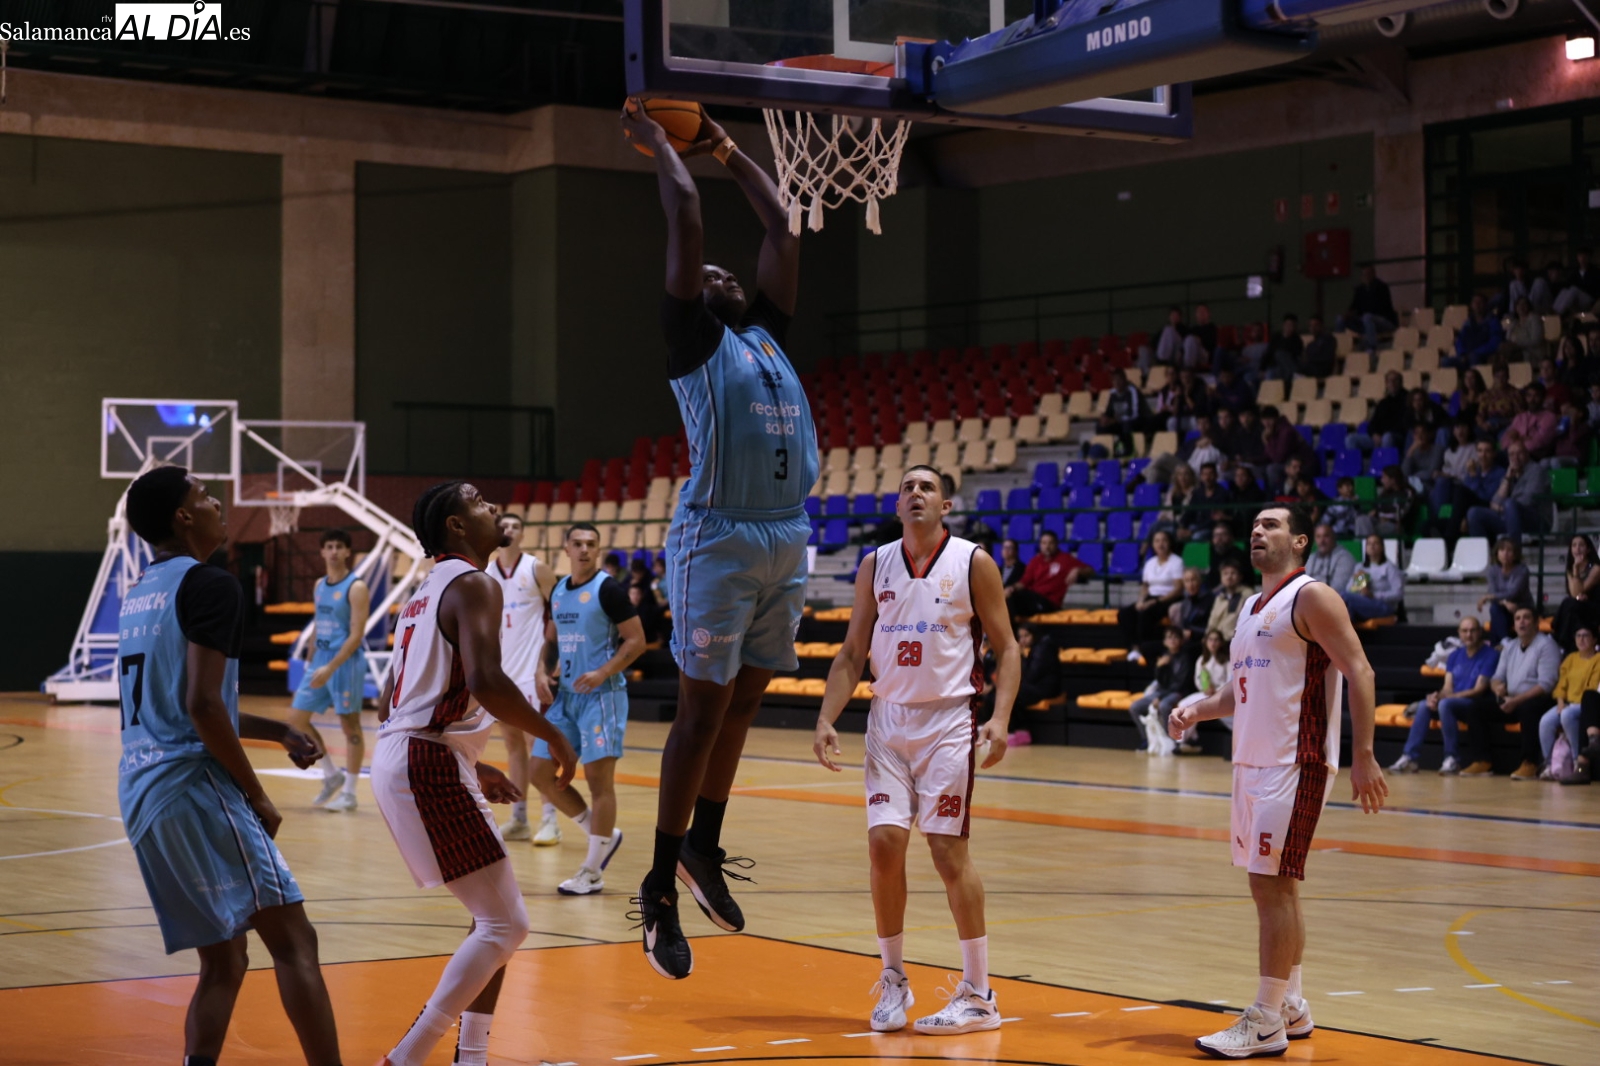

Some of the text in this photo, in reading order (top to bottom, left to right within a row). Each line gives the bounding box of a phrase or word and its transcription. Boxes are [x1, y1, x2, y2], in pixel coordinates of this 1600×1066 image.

[1087, 16, 1151, 52] MONDO
[774, 448, 788, 480] 3
[930, 623, 949, 633] 2027
[897, 640, 923, 667] 29
[564, 660, 571, 678] 2
[1239, 676, 1247, 704] 5
[937, 794, 961, 818] 29
[1258, 832, 1273, 856] 5
